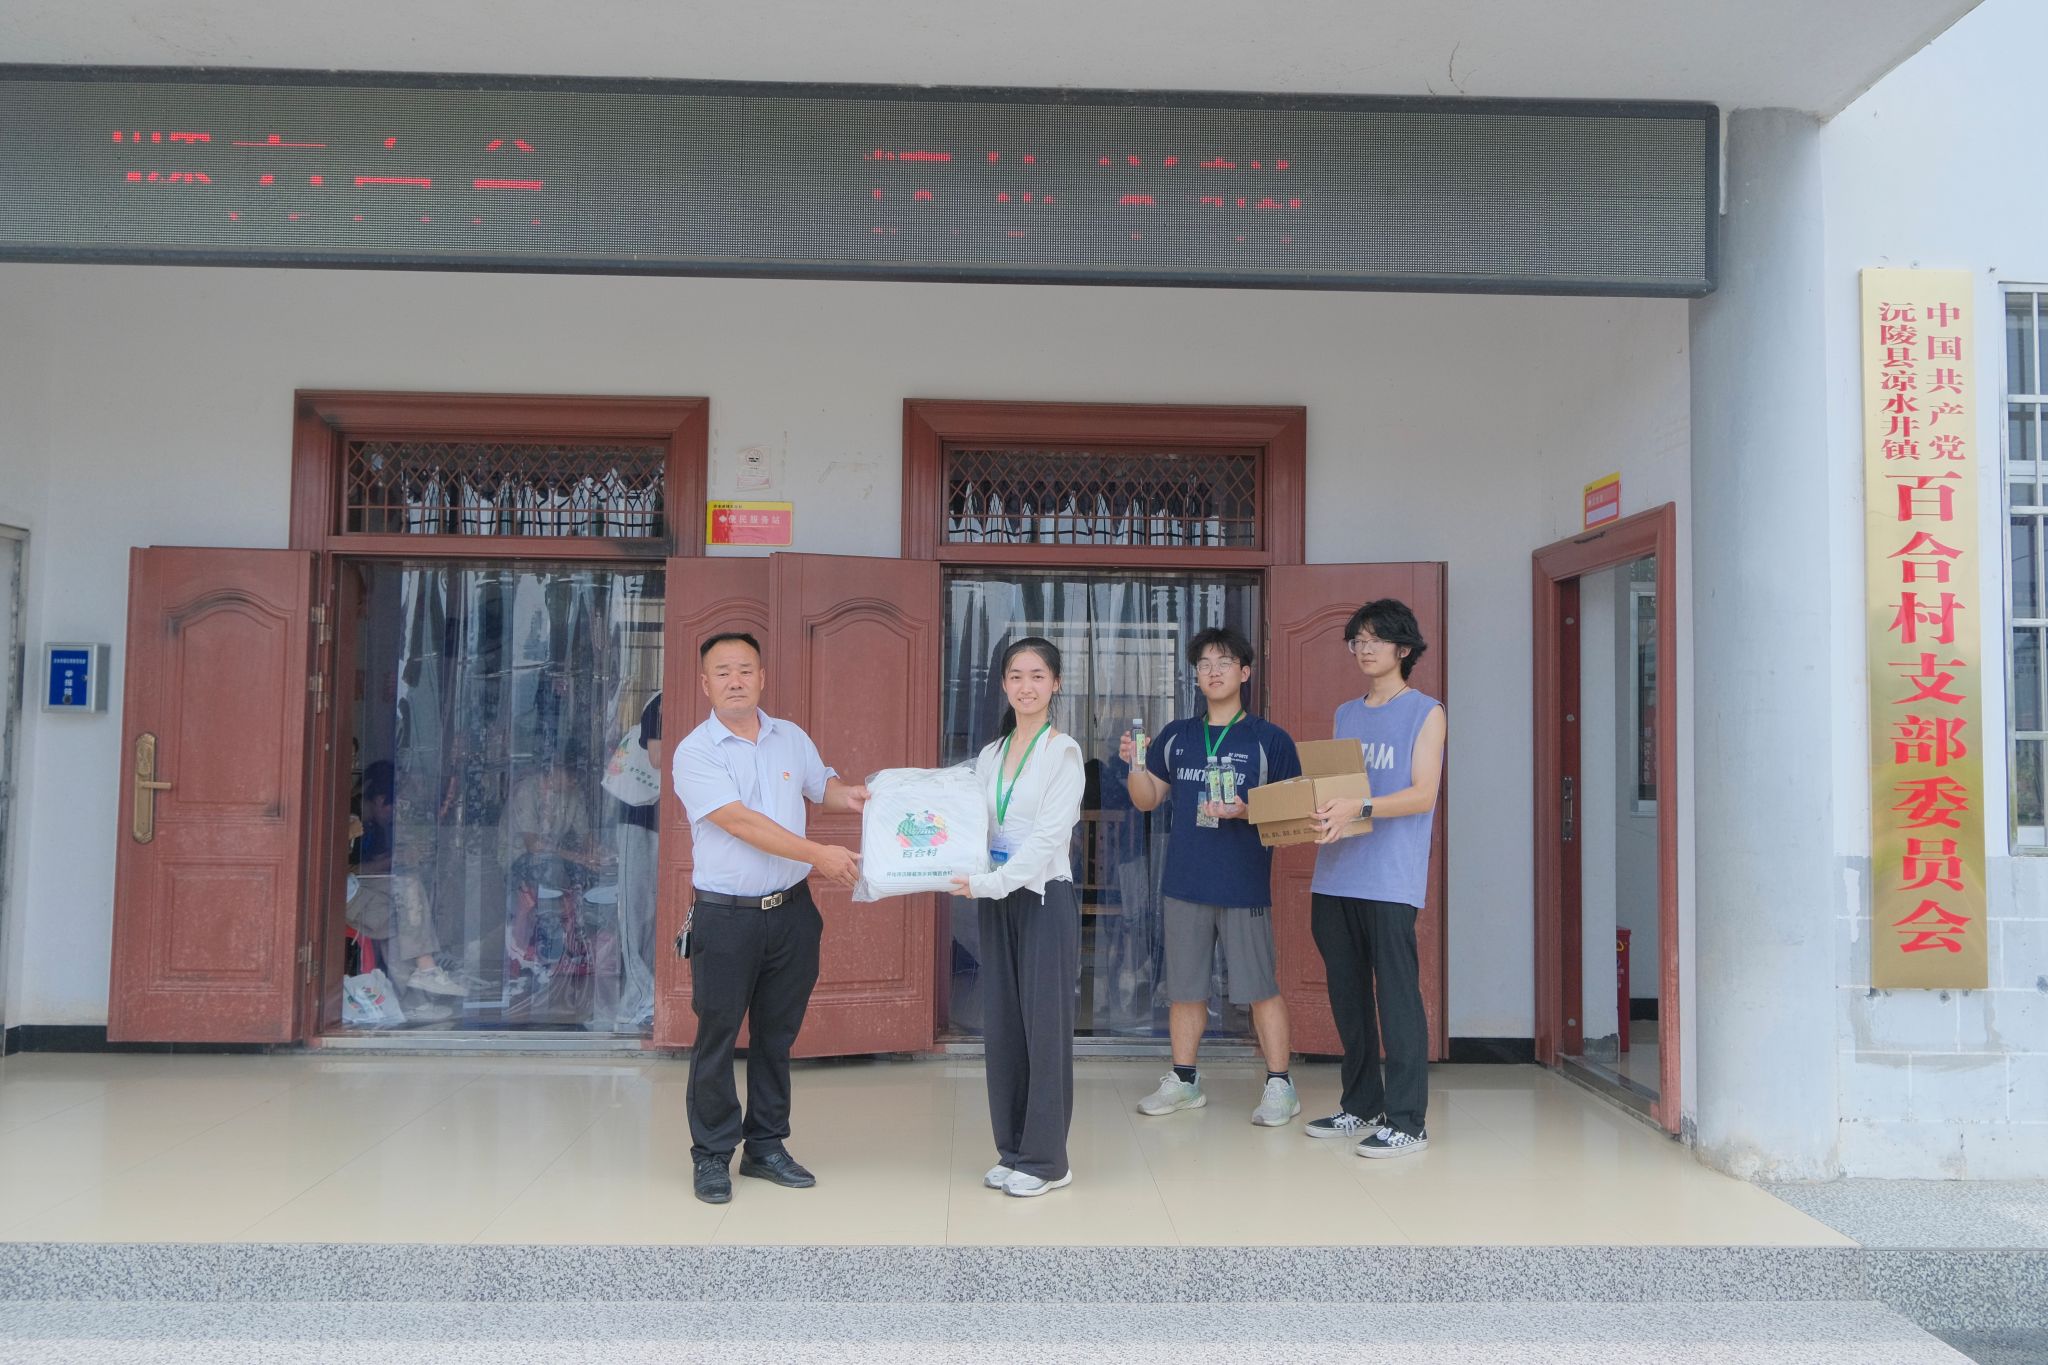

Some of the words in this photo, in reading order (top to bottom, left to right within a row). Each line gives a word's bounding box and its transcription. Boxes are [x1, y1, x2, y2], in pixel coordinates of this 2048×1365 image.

[1877, 301, 1921, 461] 沅陵县凉水井镇
[1926, 301, 1966, 461] 中国共产党
[1884, 471, 1973, 953] 百合村支部委员会
[902, 848, 938, 858] 百合村
